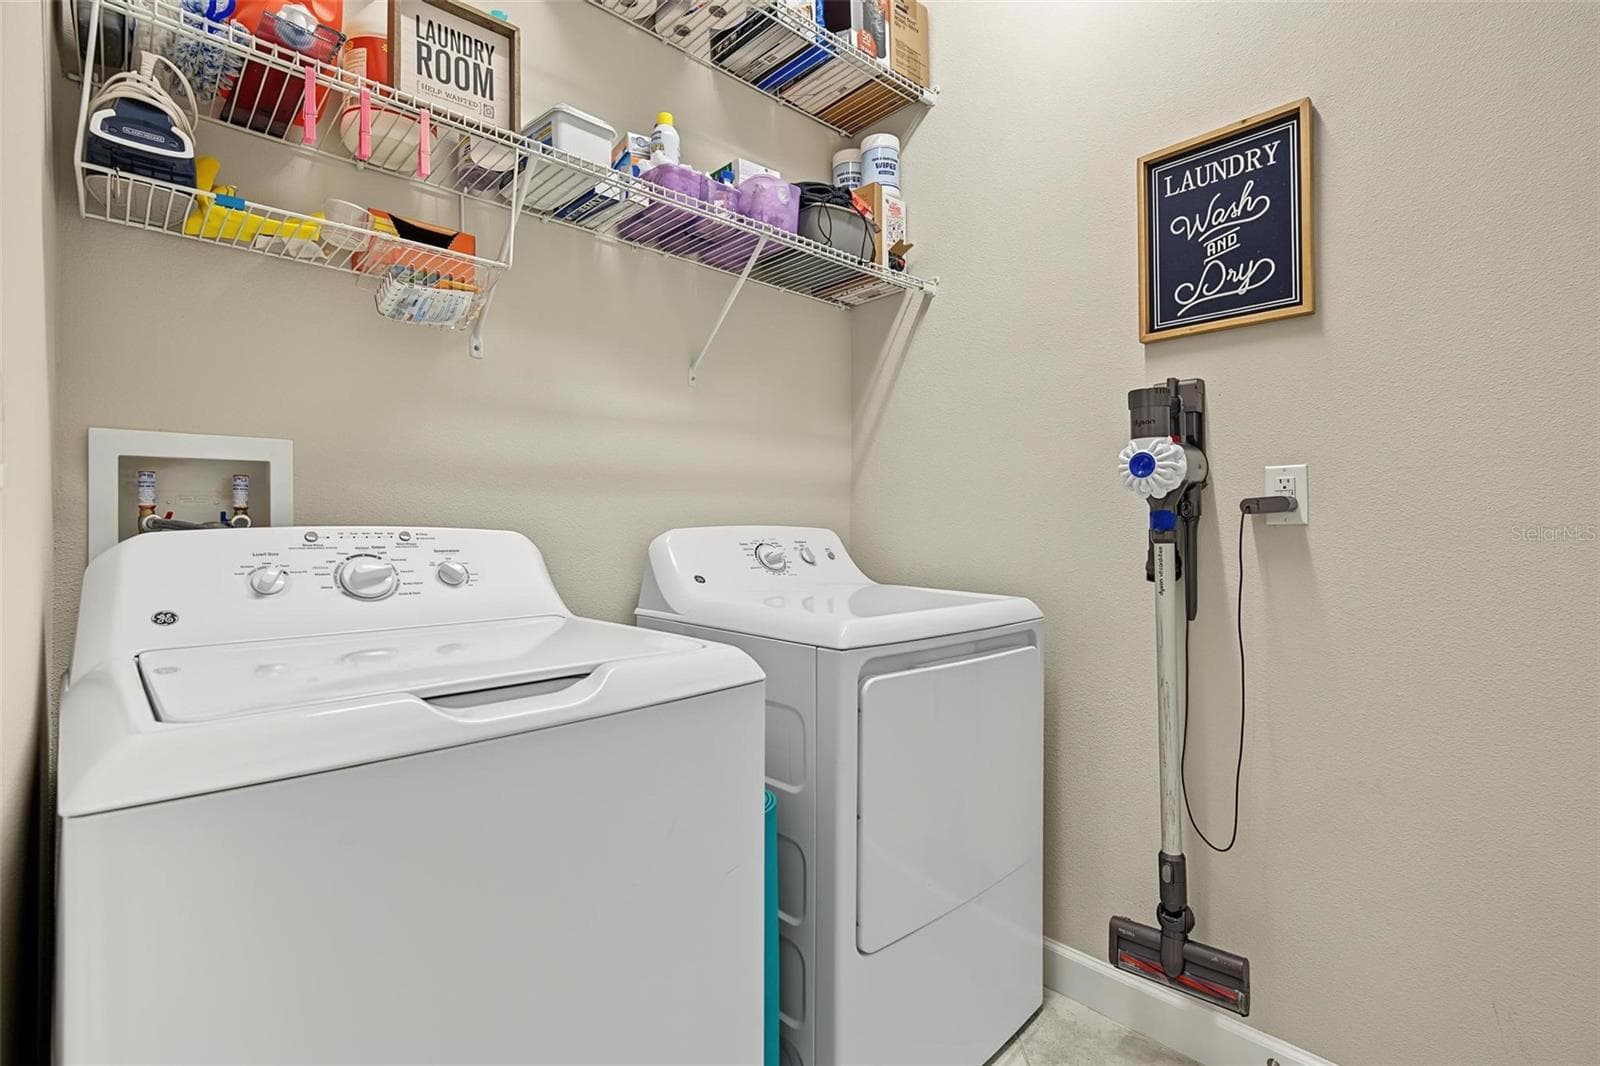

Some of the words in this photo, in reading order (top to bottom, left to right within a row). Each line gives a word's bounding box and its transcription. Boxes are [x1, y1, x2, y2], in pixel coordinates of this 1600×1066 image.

[416, 14, 495, 66] LAUNDRY
[416, 40, 494, 101] ROOM
[421, 82, 442, 95] HELP
[445, 90, 479, 108] WANTED
[875, 161, 897, 171] WIPES
[1164, 140, 1281, 198] LAUNDRY
[1170, 180, 1271, 242] Wash
[1207, 233, 1238, 256] AND
[1174, 258, 1276, 317] Dry
